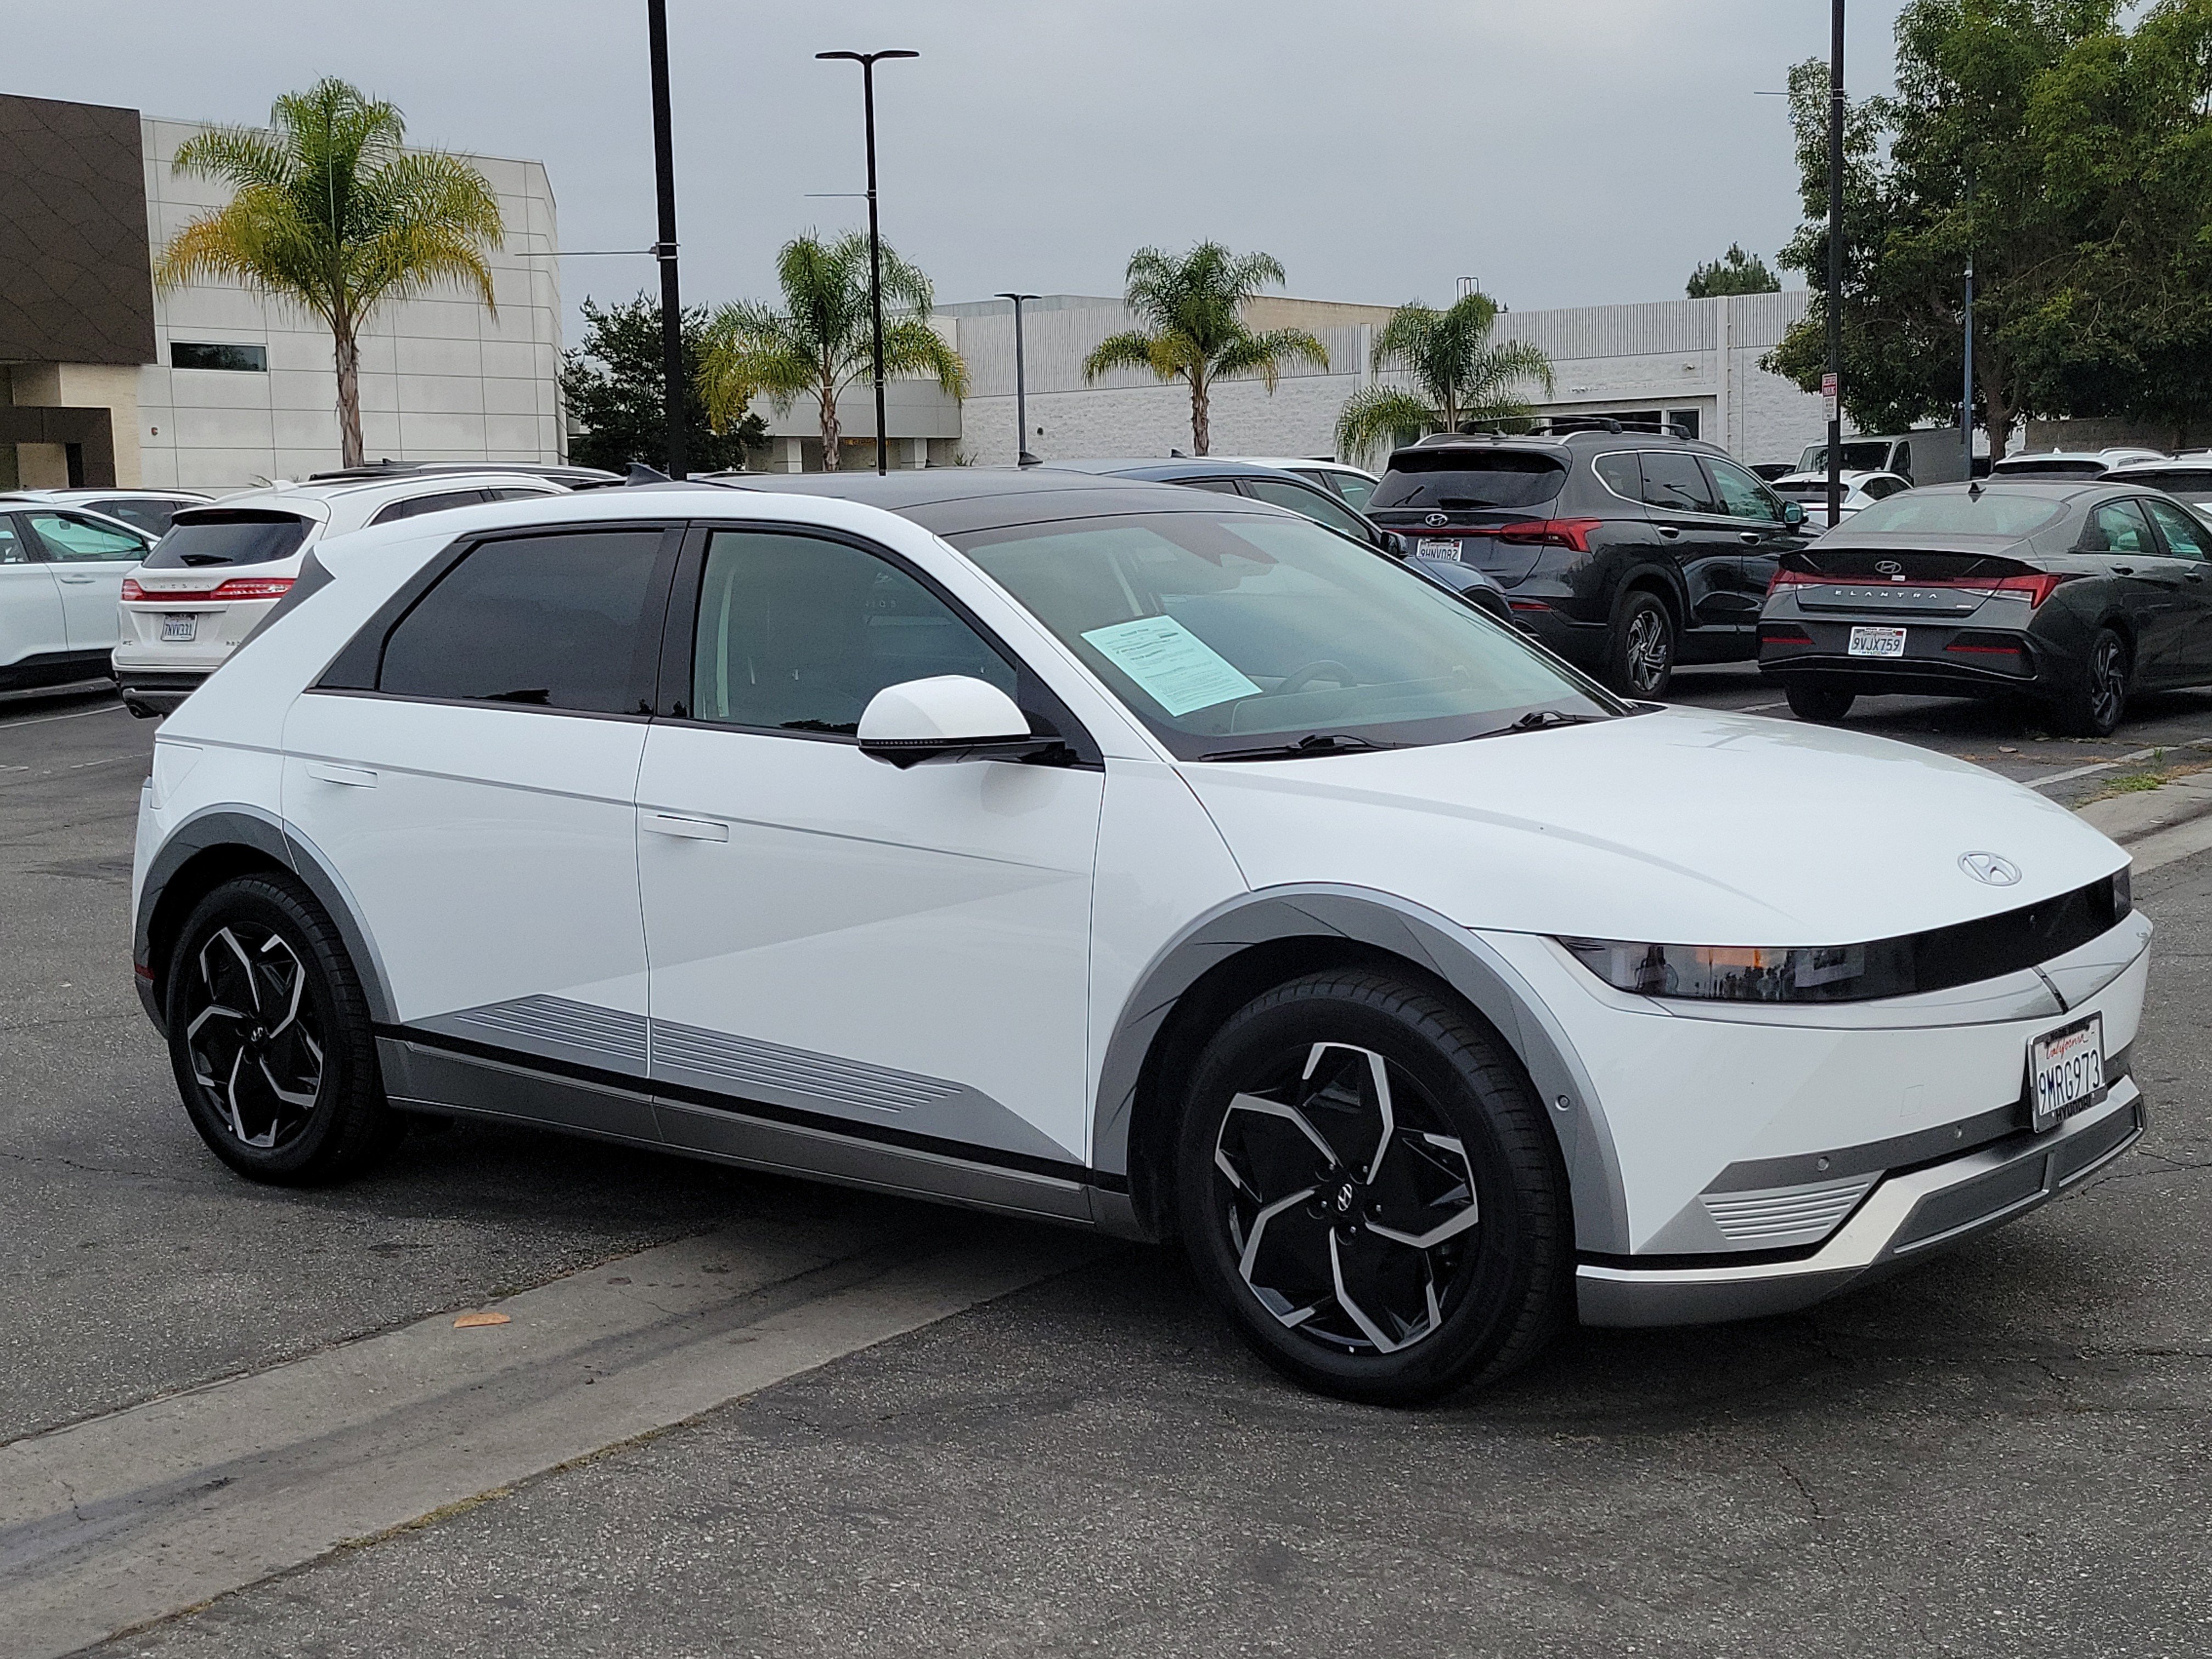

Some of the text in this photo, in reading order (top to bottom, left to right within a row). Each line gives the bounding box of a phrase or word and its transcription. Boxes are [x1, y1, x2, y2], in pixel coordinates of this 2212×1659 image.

[1835, 590, 1938, 599] ELANTRA
[1851, 637, 1900, 652] 9VJX759
[2046, 1033, 2089, 1060] California
[2038, 1048, 2100, 1115] 9MRG973
[2055, 1093, 2091, 1122] HYUNDAI
